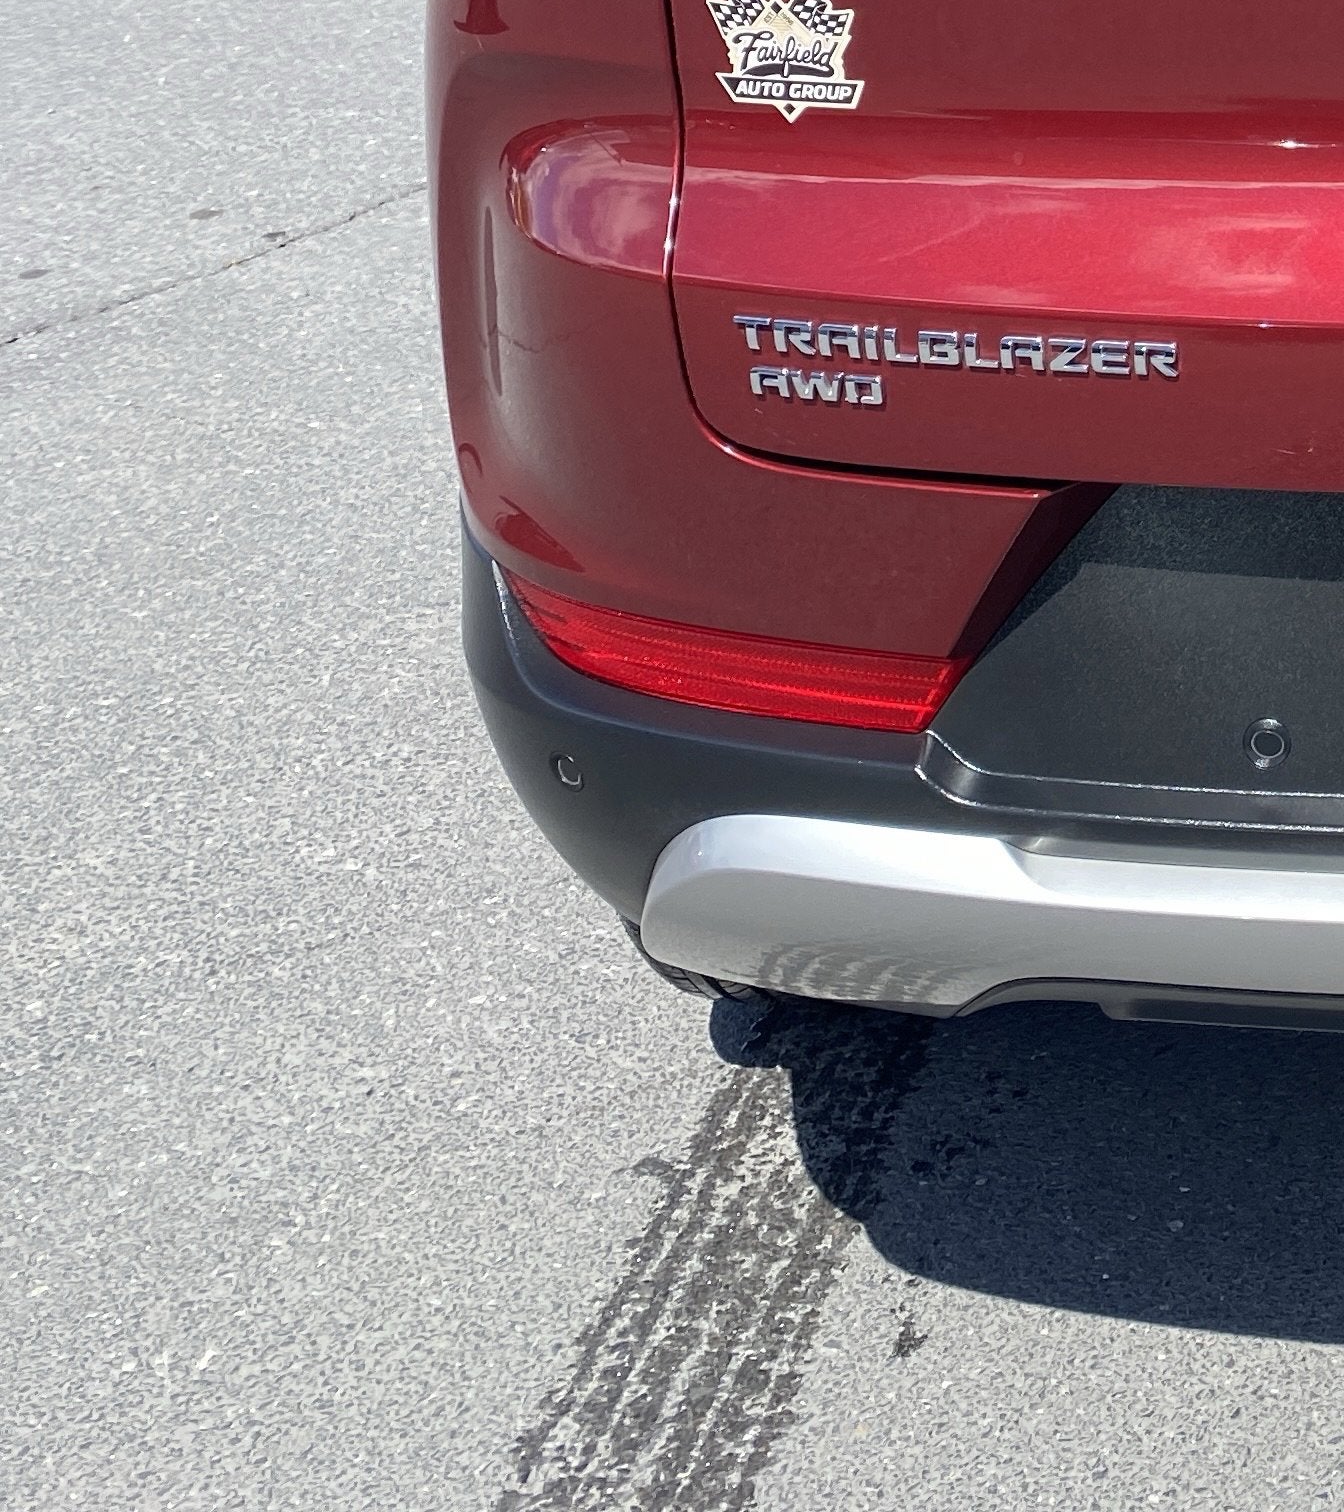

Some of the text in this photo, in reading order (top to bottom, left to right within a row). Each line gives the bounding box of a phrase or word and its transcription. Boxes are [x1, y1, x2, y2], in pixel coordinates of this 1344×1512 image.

[732, 30, 839, 78] Fairfield
[735, 80, 854, 101] AUTO GROUP
[733, 314, 1180, 379] TRAILBLAZER
[748, 364, 886, 407] AWD
